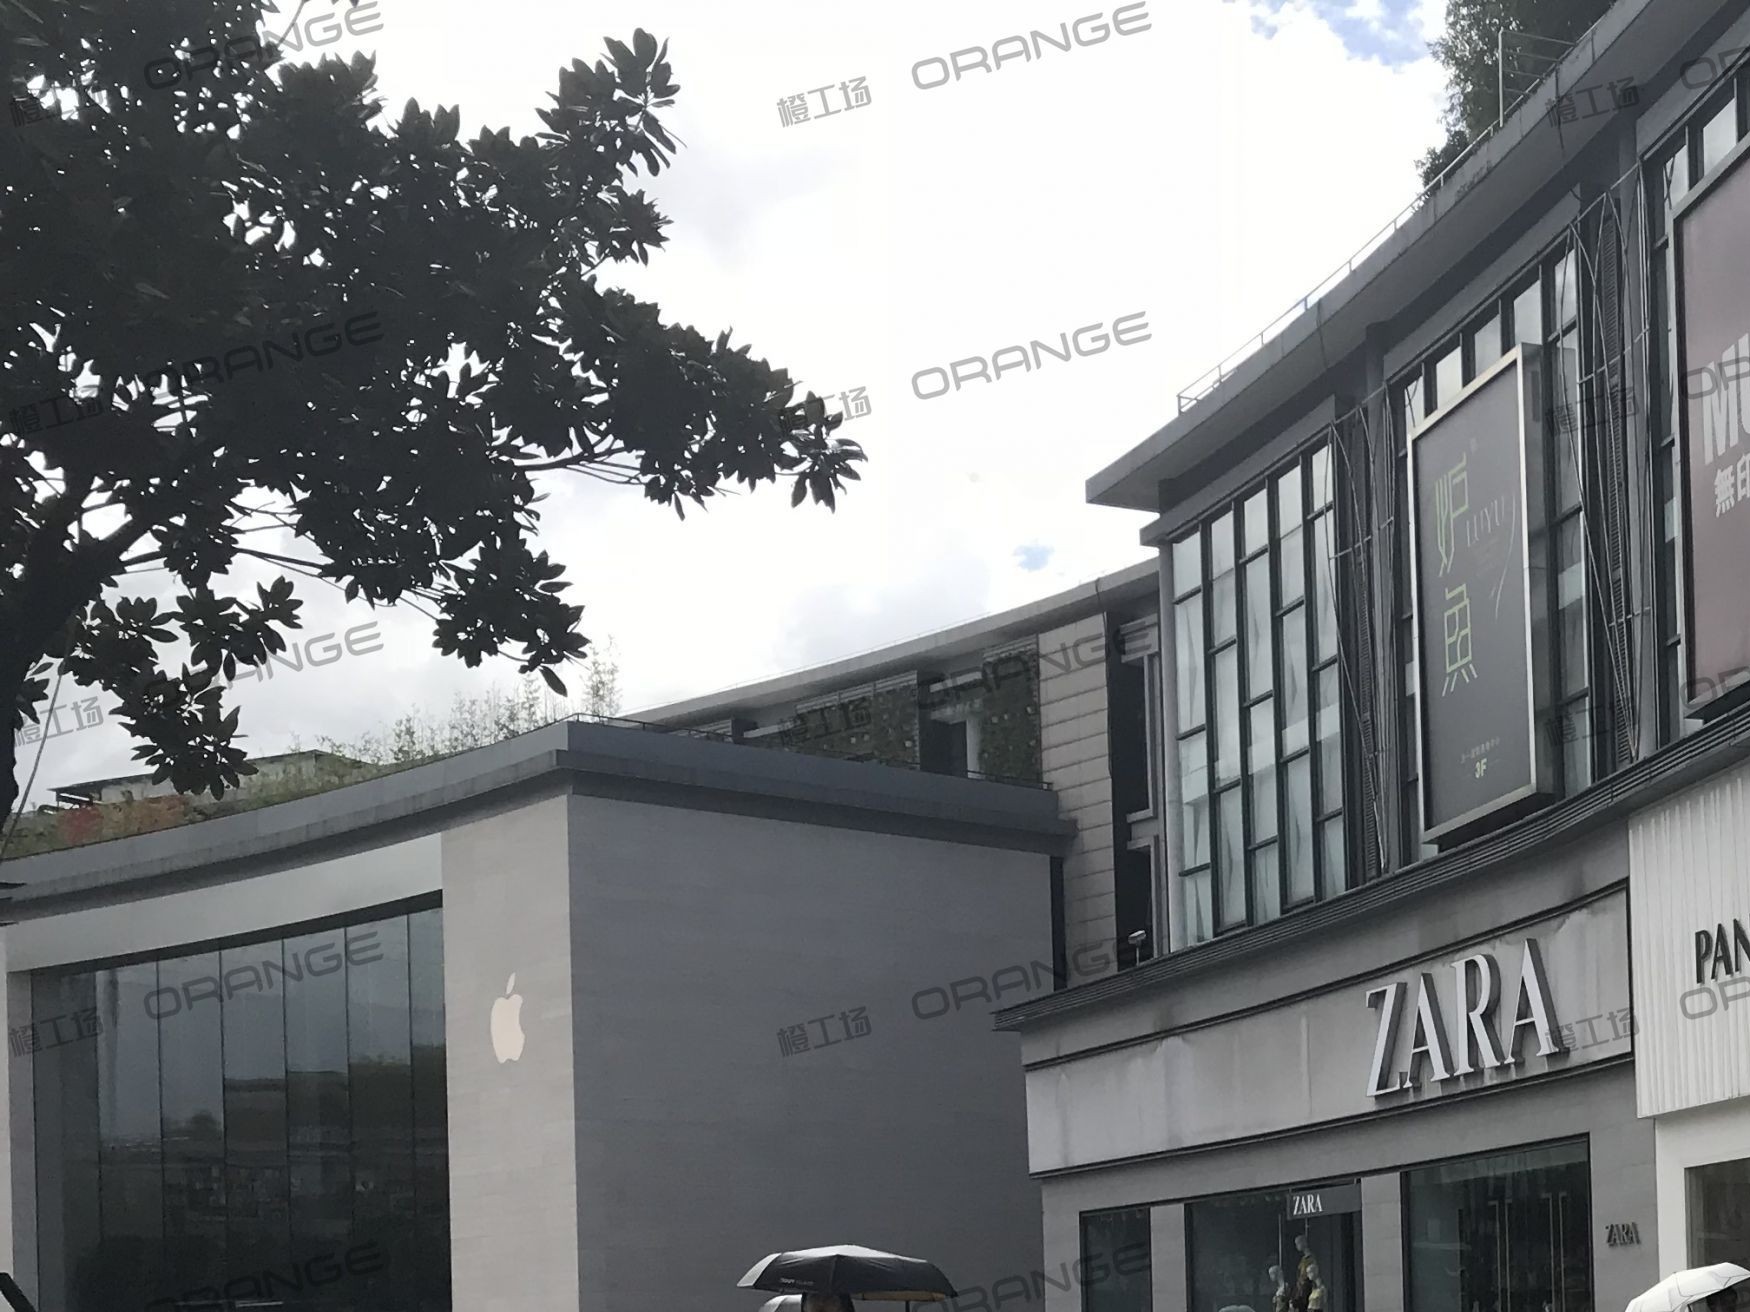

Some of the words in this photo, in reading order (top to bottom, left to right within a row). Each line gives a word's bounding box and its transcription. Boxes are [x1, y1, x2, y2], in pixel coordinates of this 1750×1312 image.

[1474, 758, 1488, 778] 3F
[1365, 938, 1572, 1099] ZARA
[1292, 1193, 1323, 1217] ZARA
[1604, 1221, 1641, 1248] ZARA
